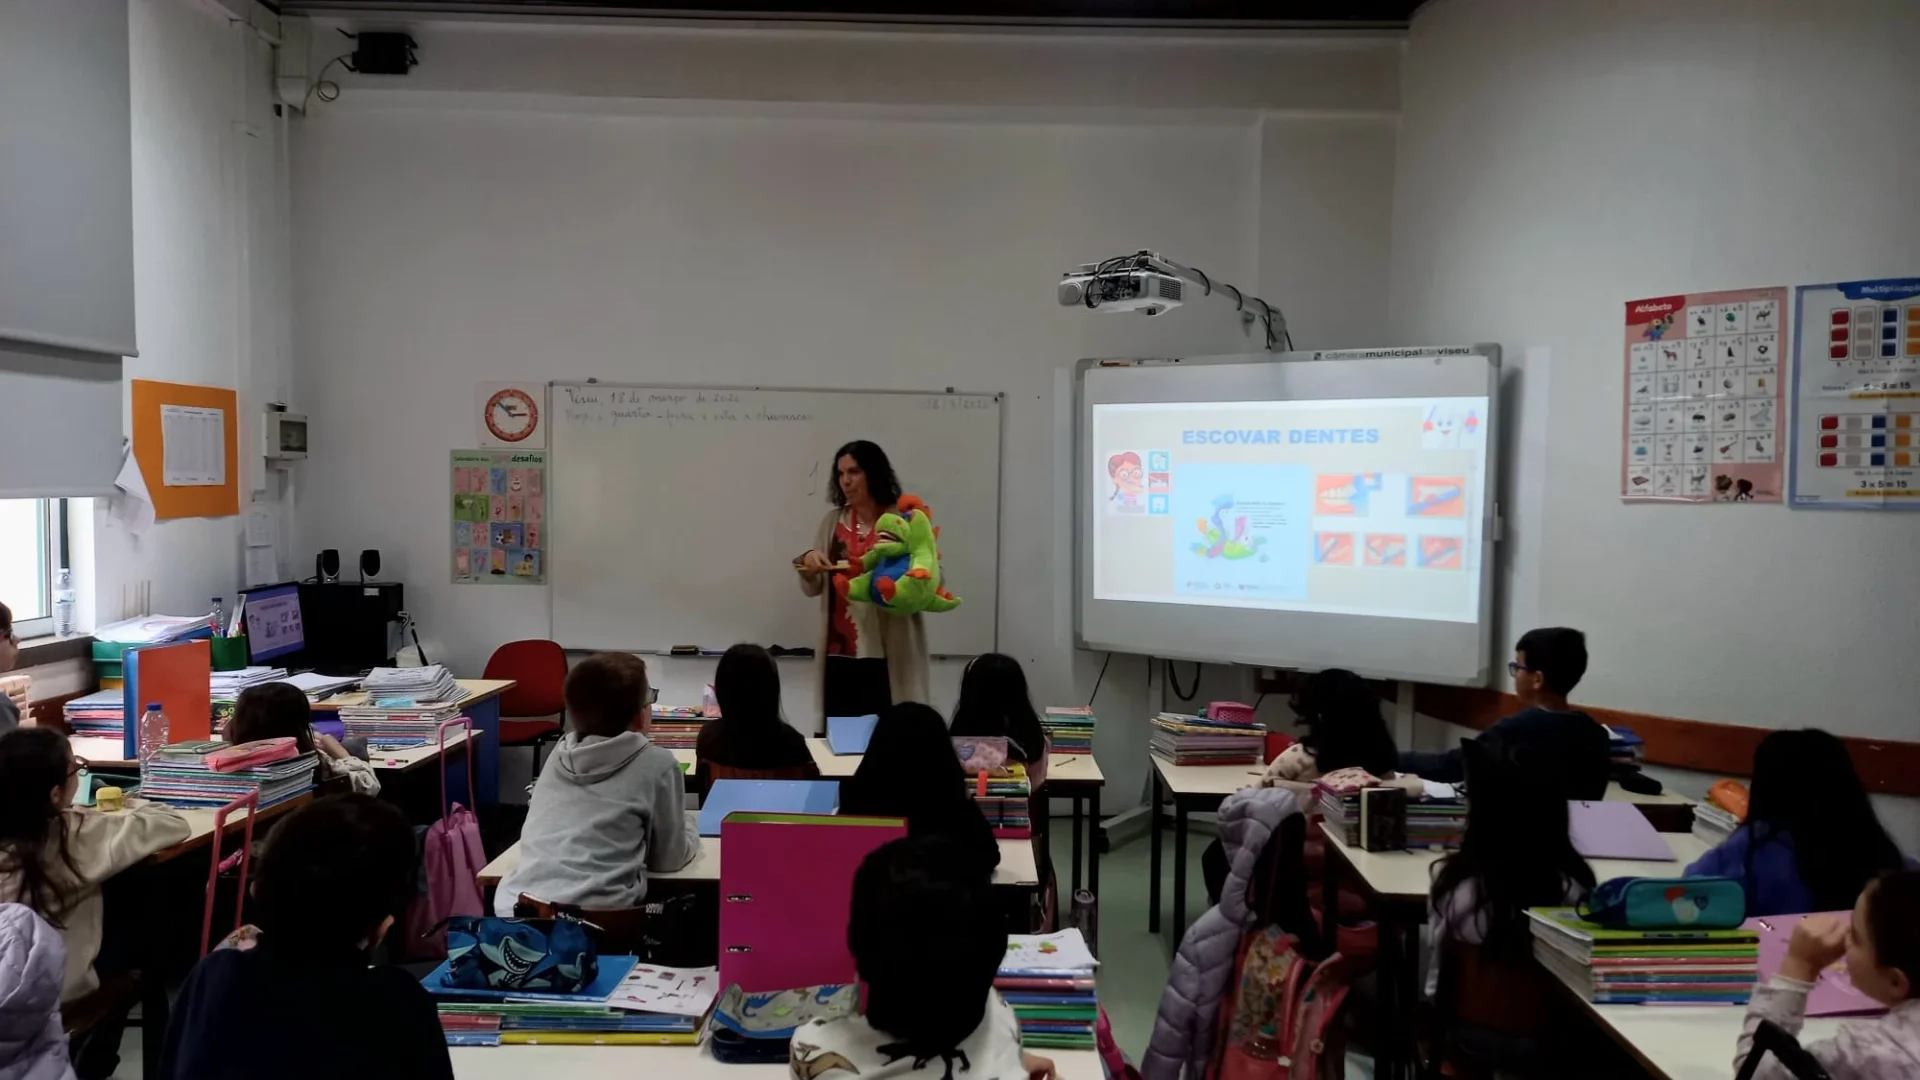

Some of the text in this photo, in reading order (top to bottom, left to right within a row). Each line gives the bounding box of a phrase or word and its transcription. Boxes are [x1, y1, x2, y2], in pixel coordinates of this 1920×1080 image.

[1634, 303, 1673, 314] Alfabeto
[1182, 428, 1380, 445] ESCOVAR DENTES
[511, 454, 543, 463] desafios
